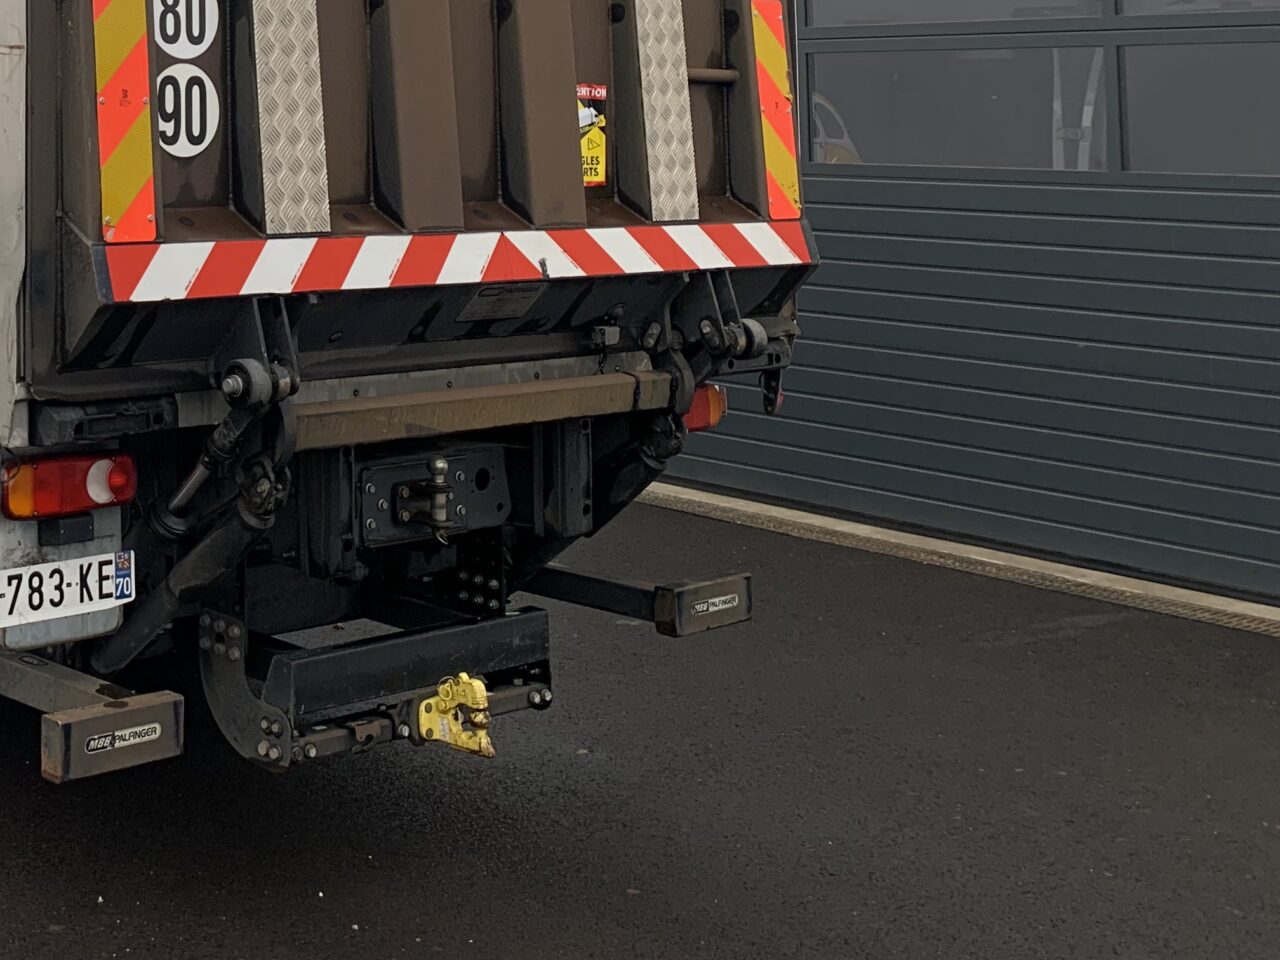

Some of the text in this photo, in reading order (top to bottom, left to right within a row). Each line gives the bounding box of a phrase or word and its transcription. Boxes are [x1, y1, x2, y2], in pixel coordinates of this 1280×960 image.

[158, 75, 207, 146] 90
[116, 577, 131, 596] 70
[88, 726, 158, 751] MBB PALFINGER
